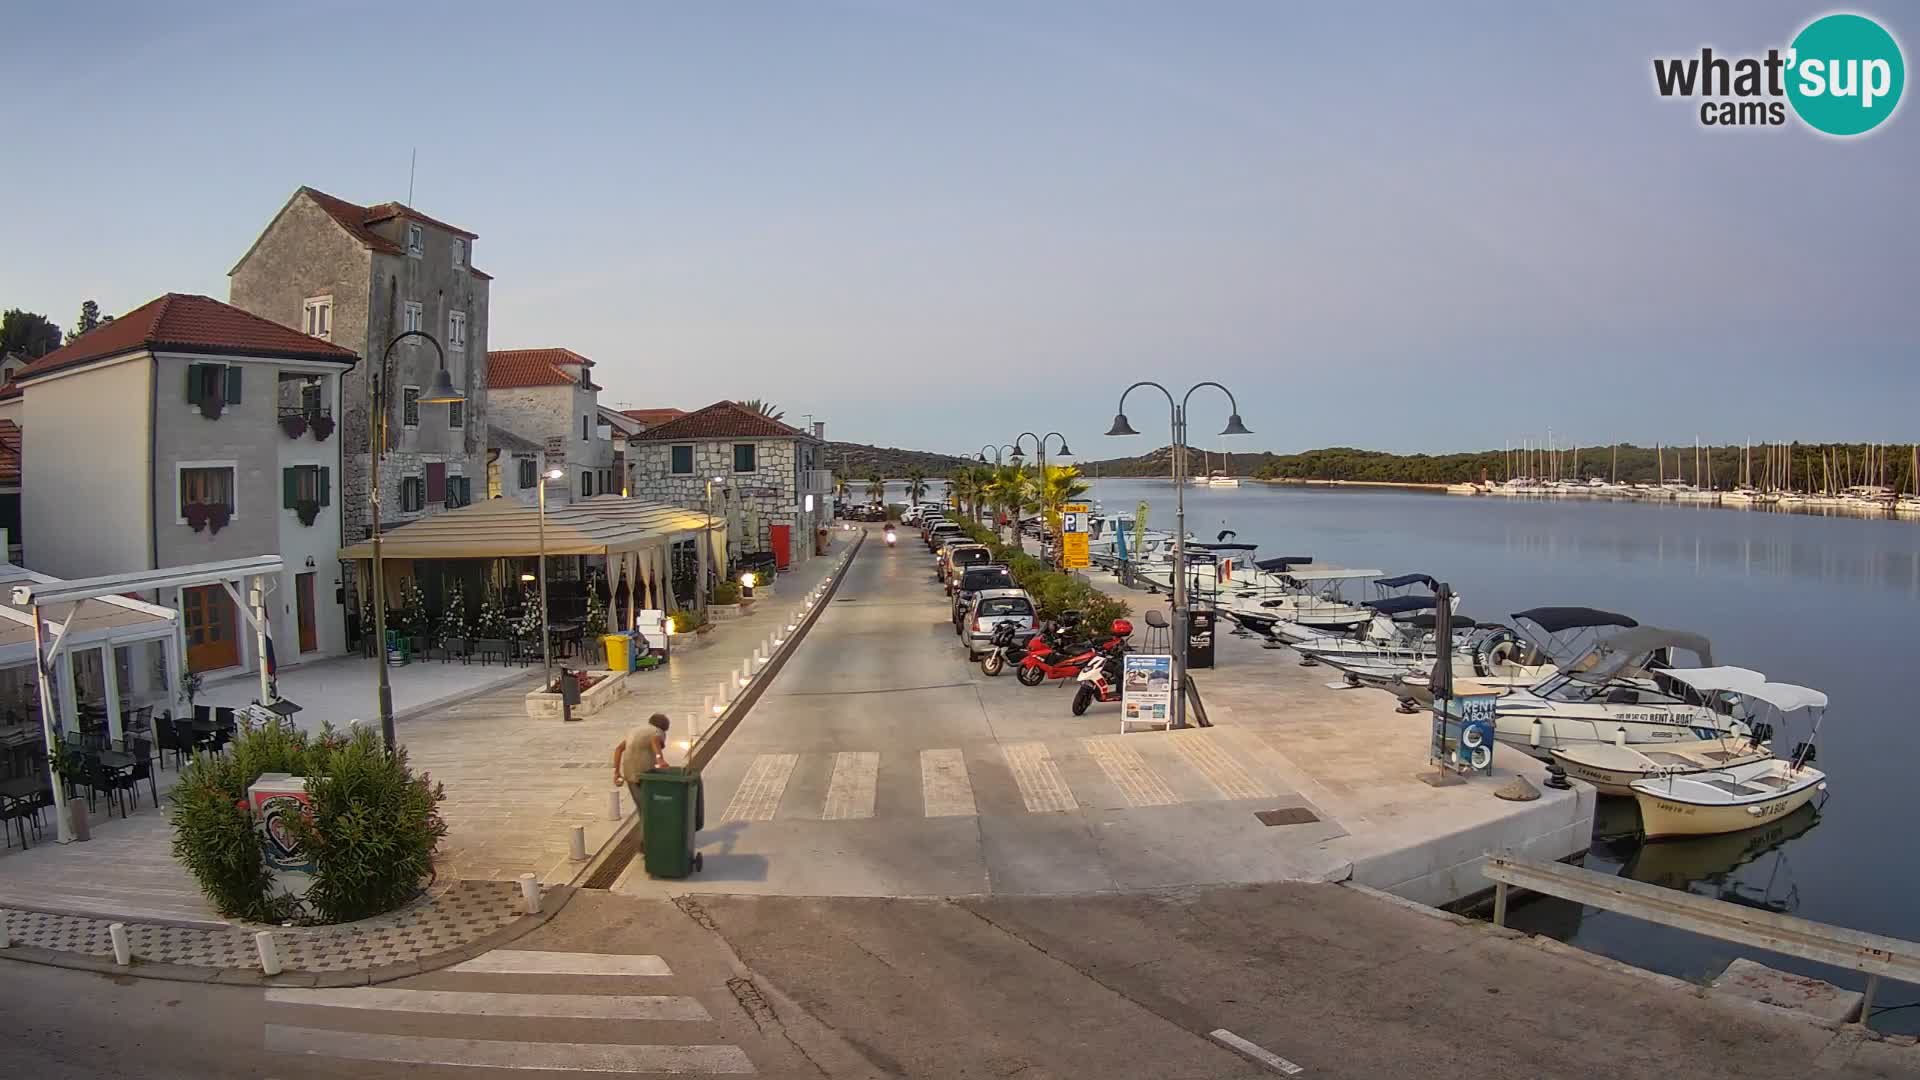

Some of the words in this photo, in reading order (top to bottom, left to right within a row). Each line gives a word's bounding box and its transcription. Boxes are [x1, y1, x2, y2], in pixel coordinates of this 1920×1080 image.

[1463, 701, 1495, 713] RENT
[1463, 712, 1470, 722] A
[1471, 712, 1495, 721] BOAT
[1649, 713, 1668, 724] RENT
[1675, 714, 1693, 725] BOAT
